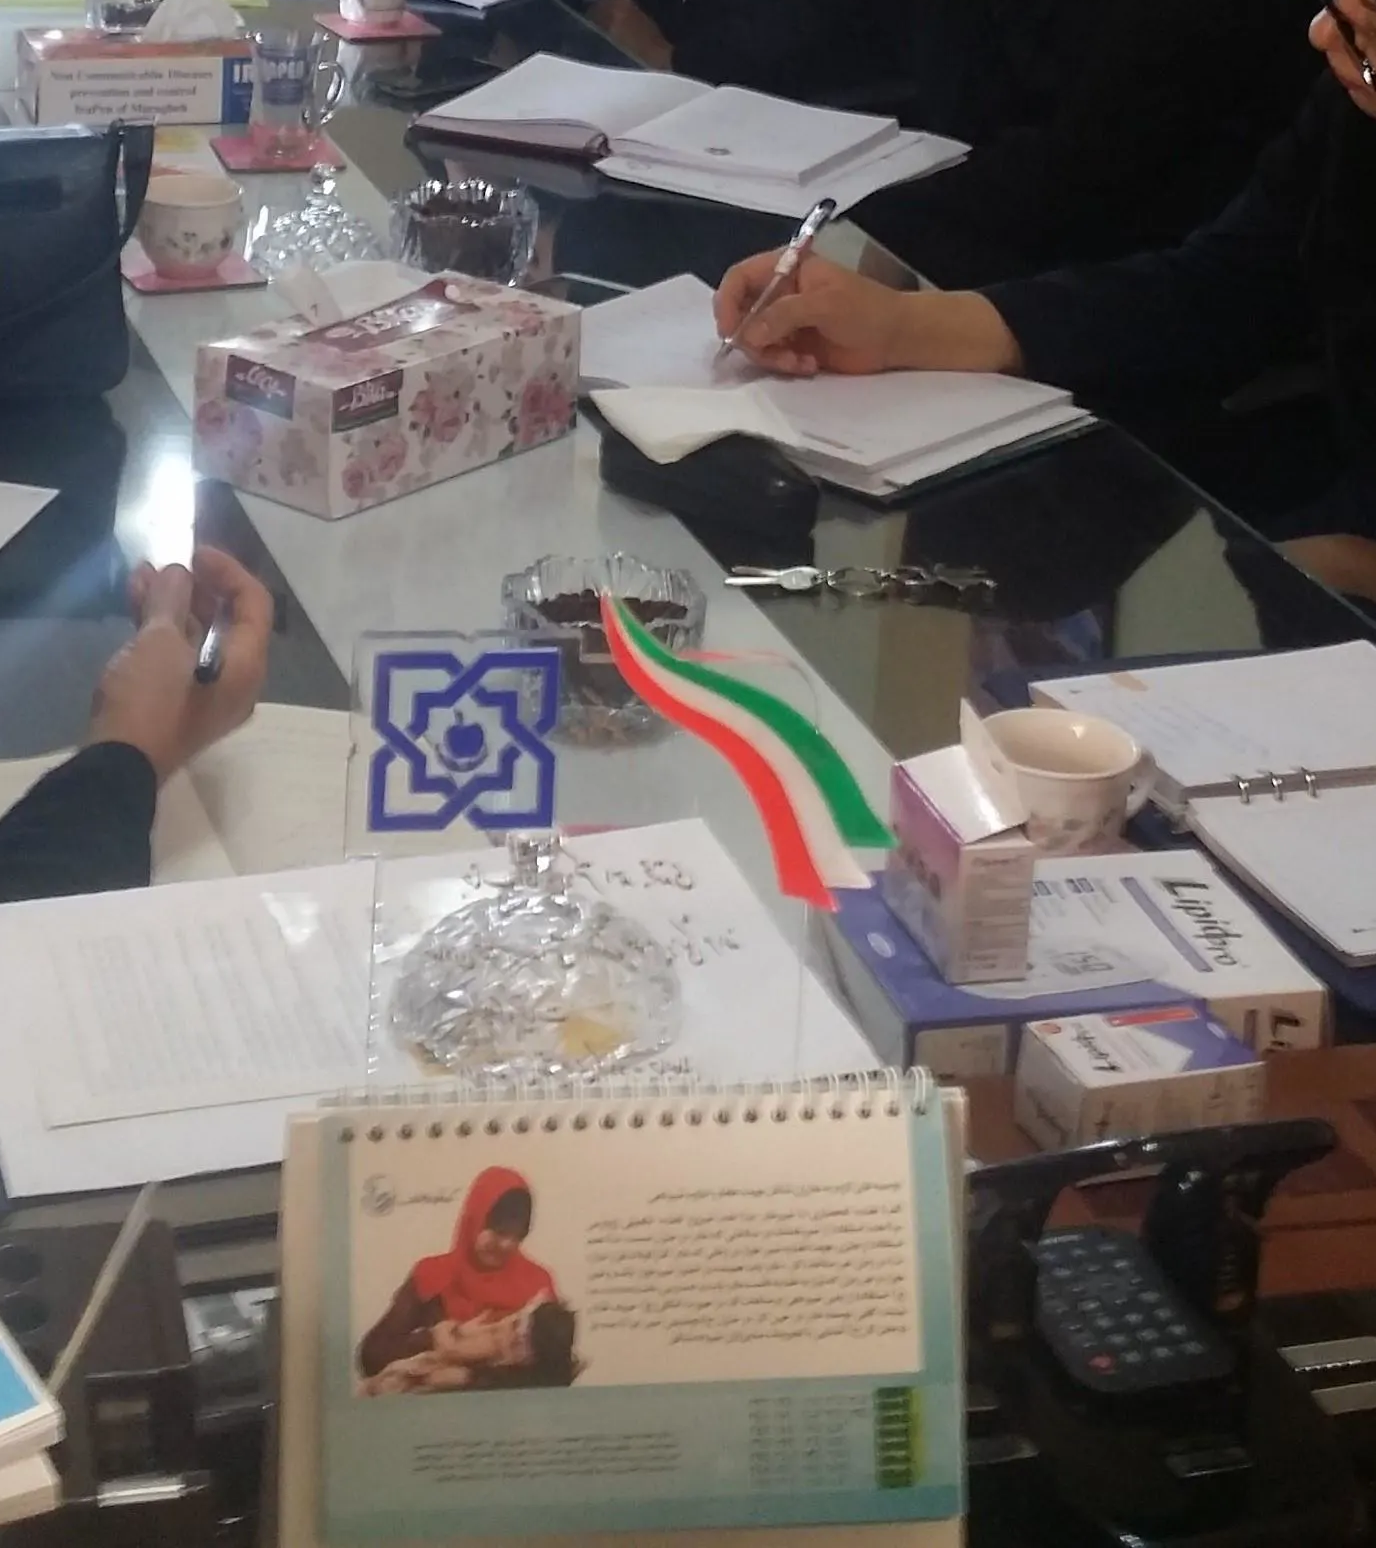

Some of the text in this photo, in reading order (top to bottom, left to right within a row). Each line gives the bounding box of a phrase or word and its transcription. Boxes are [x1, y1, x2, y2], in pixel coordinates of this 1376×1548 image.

[51, 68, 213, 81] Non Communicable Diseases
[70, 86, 196, 99] prevention and control
[116, 103, 128, 115] of
